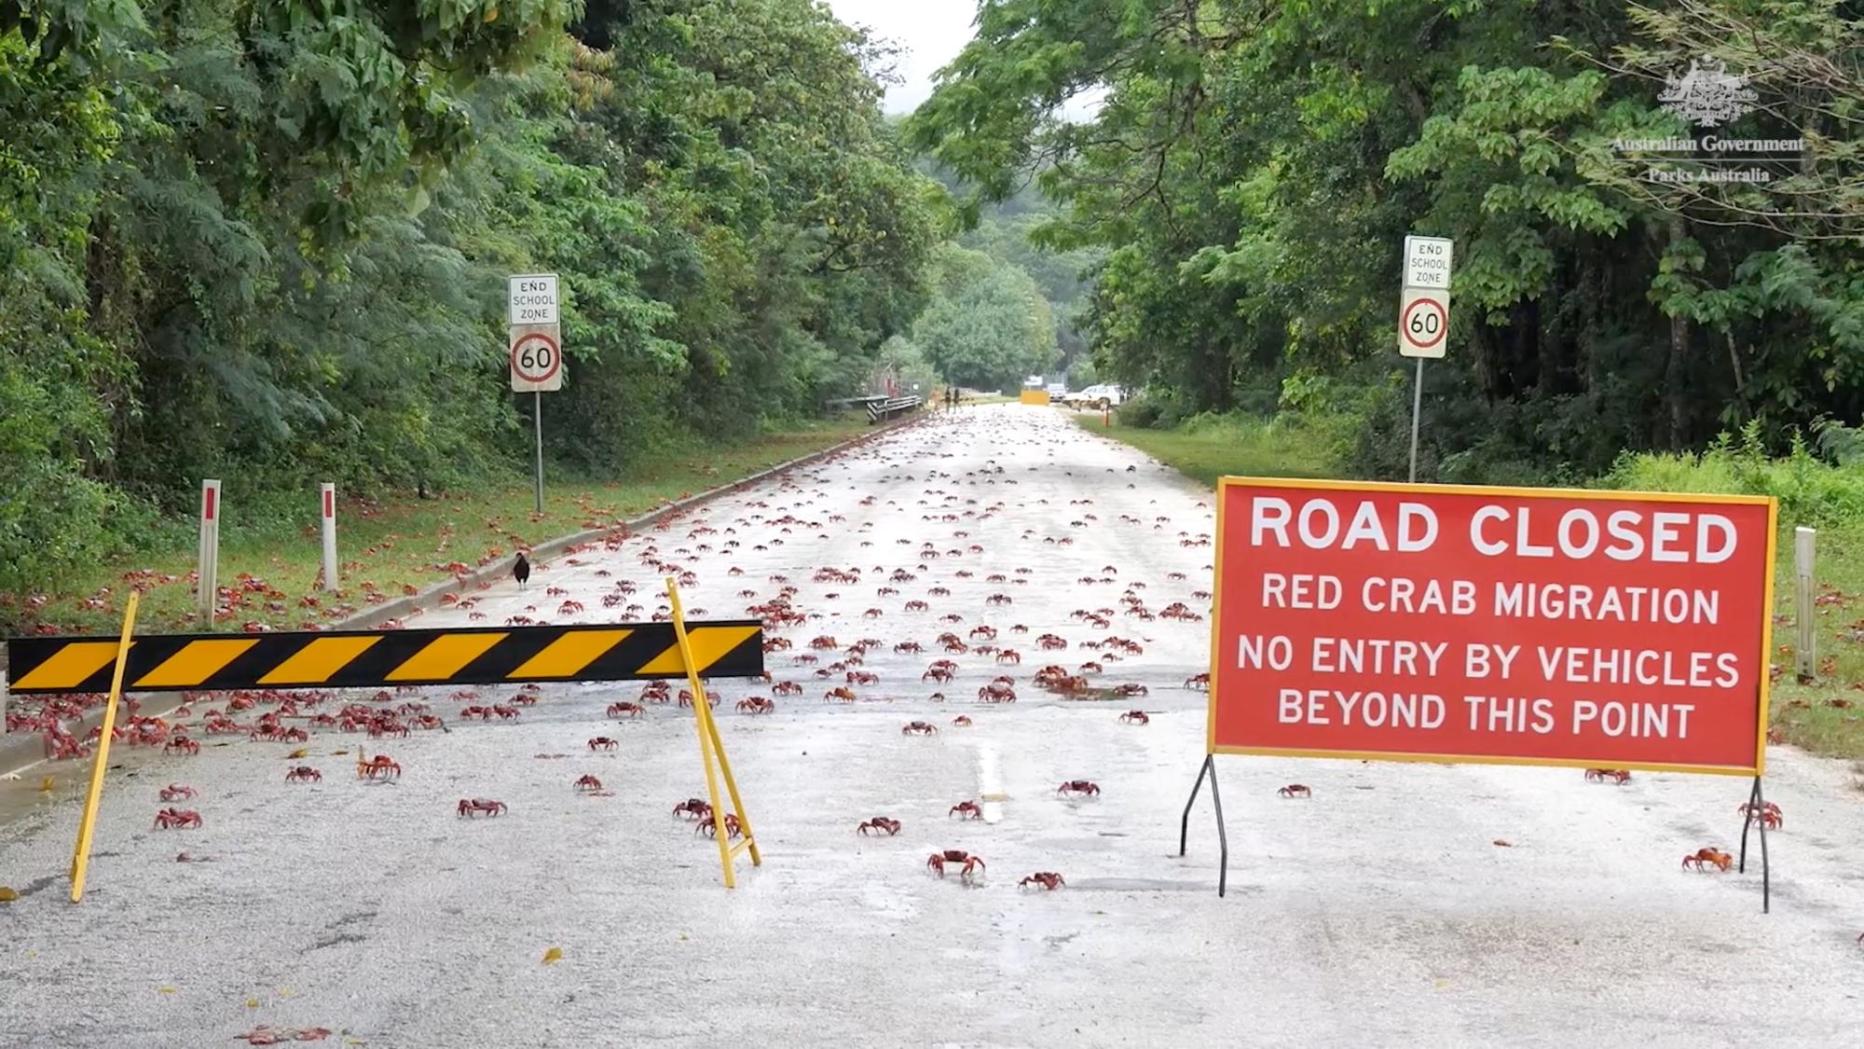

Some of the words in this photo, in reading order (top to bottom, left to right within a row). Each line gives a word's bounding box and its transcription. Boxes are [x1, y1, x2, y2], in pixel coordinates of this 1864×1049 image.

[1419, 244, 1443, 255] END
[1411, 258, 1447, 270] SCHOOL
[1416, 272, 1441, 283] ZONE
[520, 282, 547, 292] END
[513, 295, 554, 306] SCHOOL
[520, 309, 549, 319] ZONE
[1411, 313, 1438, 334] 60
[521, 347, 551, 369] 60
[1252, 497, 1438, 552] ROAD
[1470, 506, 1738, 563] CLOSED
[1263, 573, 1342, 609] RED
[1363, 577, 1476, 614] CRAB
[1495, 582, 1718, 624] MIGRATION
[1238, 635, 1292, 670] NO
[1313, 638, 1448, 676] ENTRY
[1466, 644, 1520, 678] BY
[1538, 647, 1738, 688] VEHICLES
[1279, 689, 1445, 728] BEYOND
[1464, 696, 1554, 733] THIS
[1573, 701, 1694, 738] POINT
